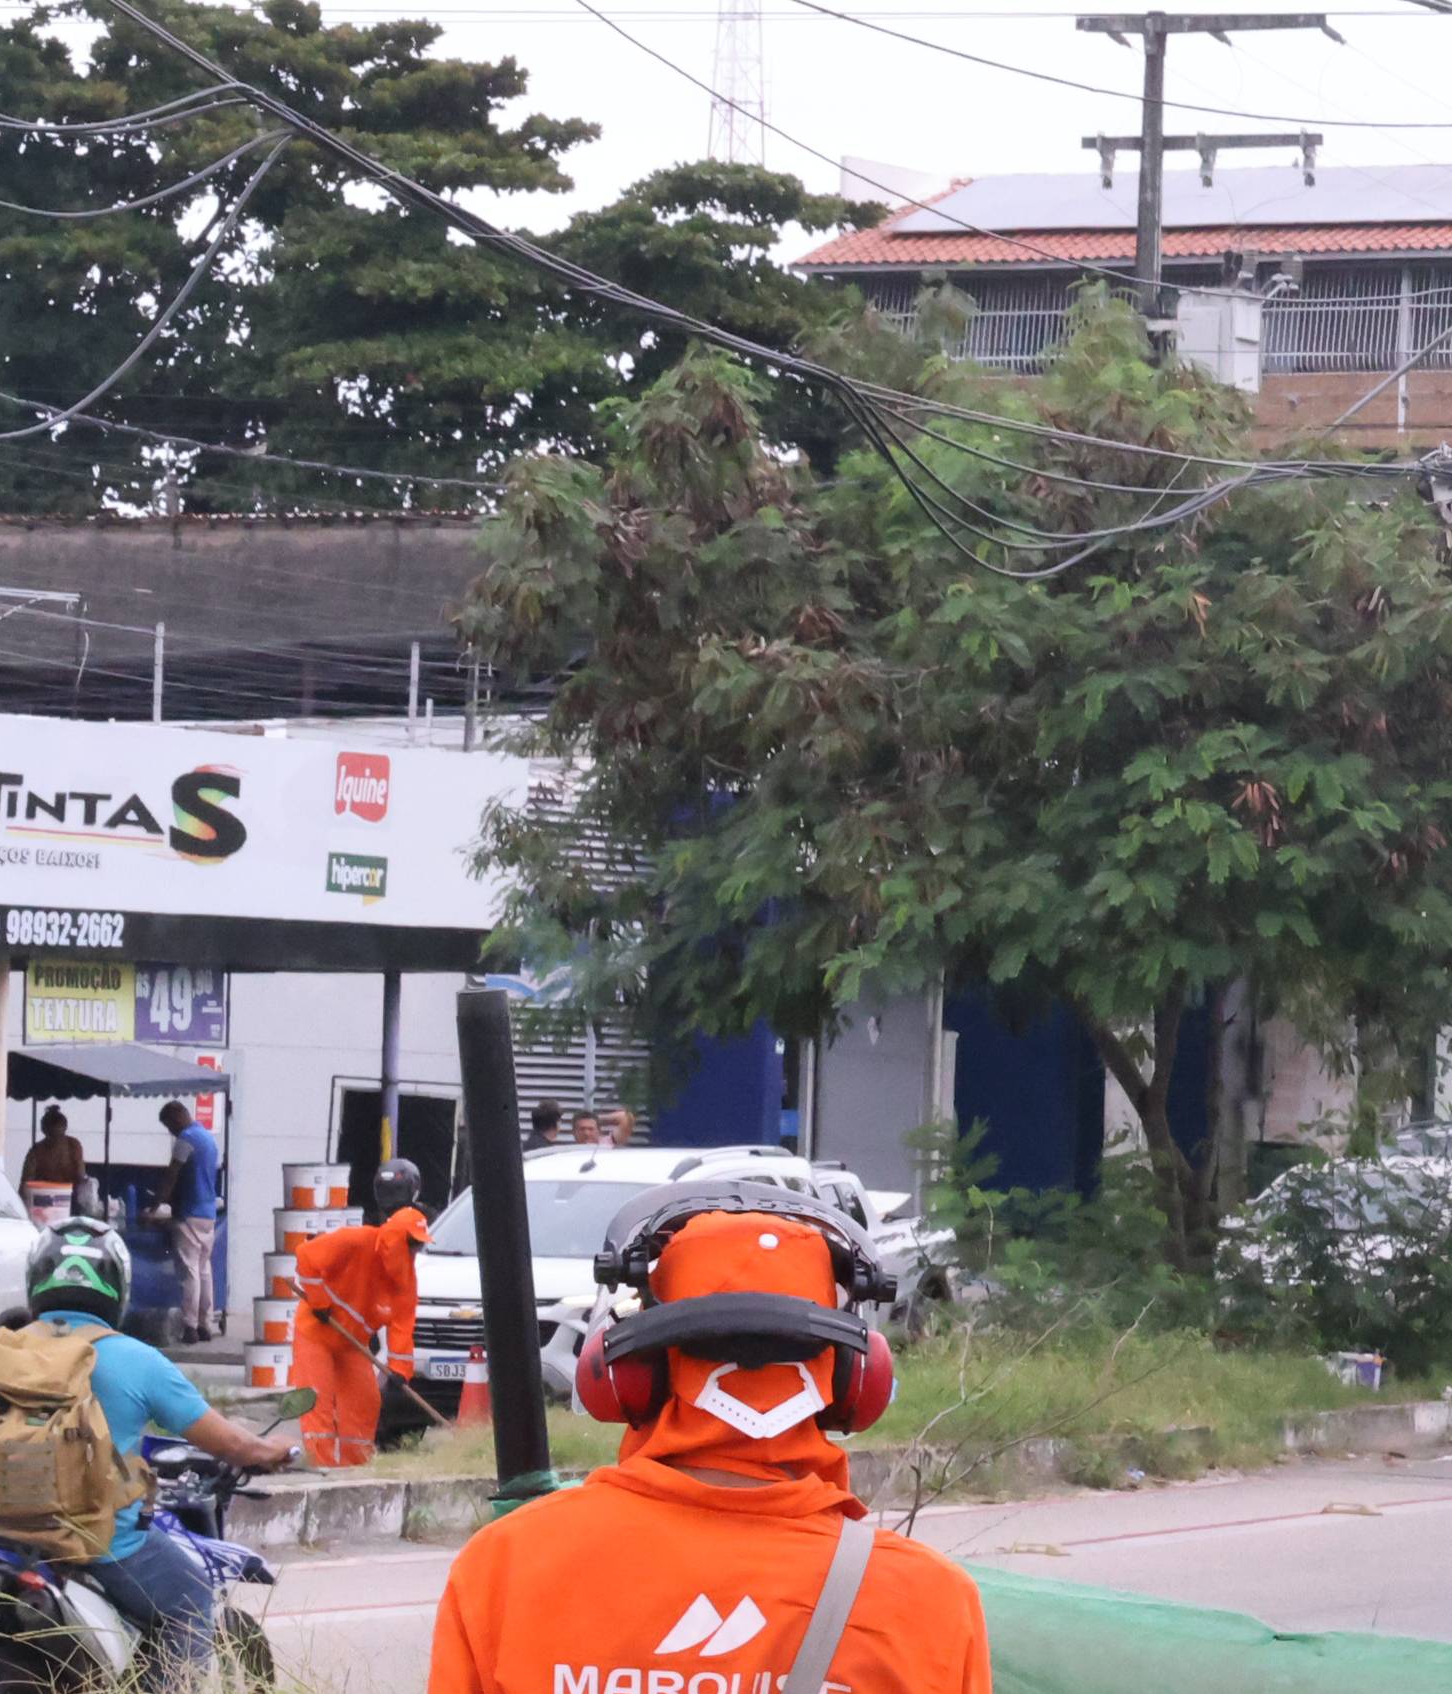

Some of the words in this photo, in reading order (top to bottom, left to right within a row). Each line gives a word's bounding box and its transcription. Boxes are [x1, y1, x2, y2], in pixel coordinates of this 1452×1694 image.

[336, 764, 388, 811] Iquine
[35, 849, 101, 868] BAIXOS!
[331, 857, 384, 890] hipercor
[6, 909, 125, 948] 98932-2662
[35, 964, 121, 991] PROMOÇÃO
[31, 999, 117, 1032] TEXTURA
